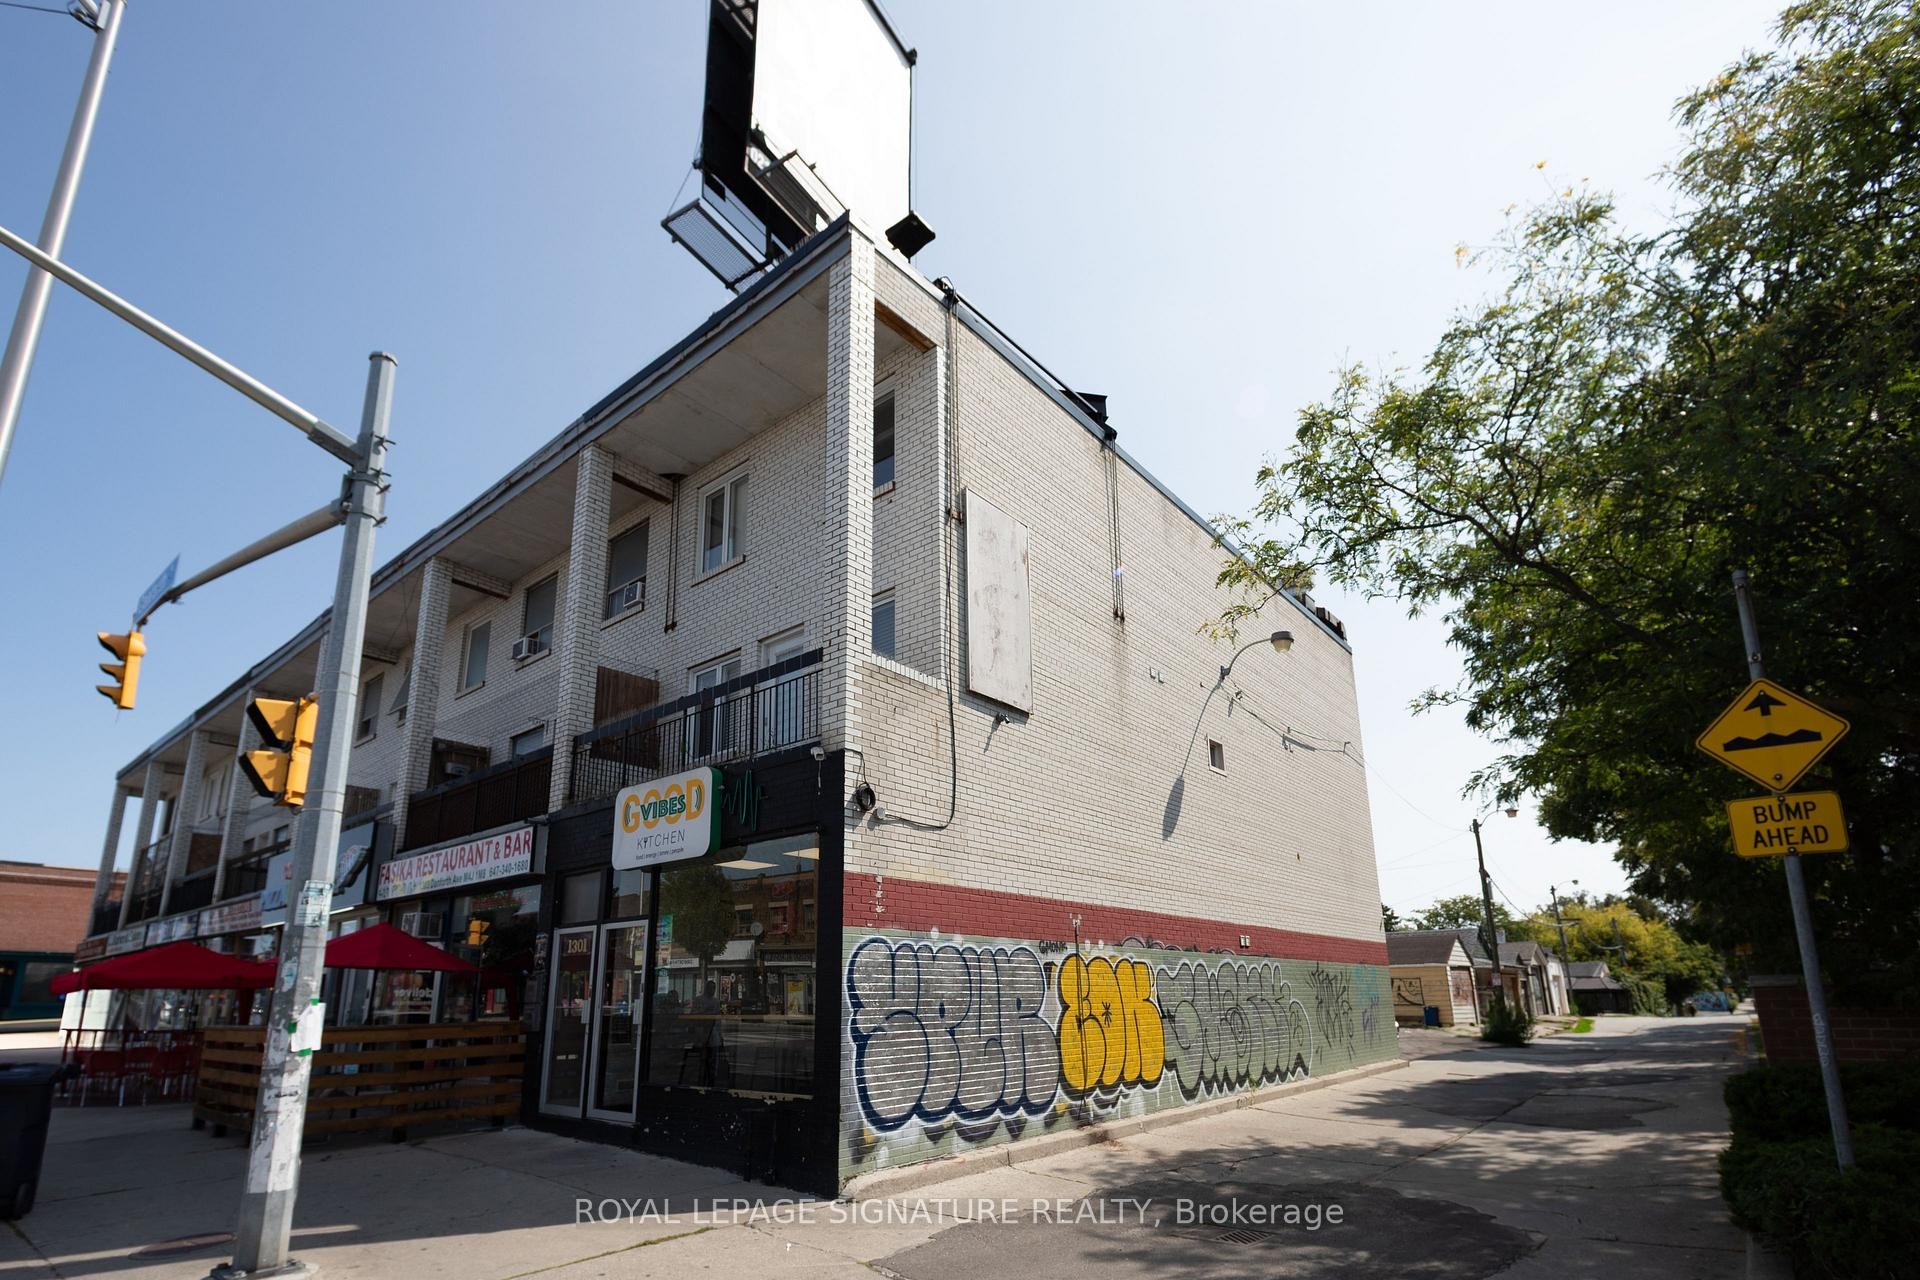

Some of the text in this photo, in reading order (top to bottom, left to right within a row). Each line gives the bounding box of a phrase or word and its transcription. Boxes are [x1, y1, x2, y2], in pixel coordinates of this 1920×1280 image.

[622, 779, 705, 833] GOOD
[640, 794, 686, 821] VIBES
[1753, 801, 1817, 824] BUMP
[636, 829, 686, 850] KITCHEN
[1753, 825, 1829, 849] AHEAD
[378, 860, 413, 885] FASIKA
[416, 840, 493, 877] RESTAURANT
[494, 841, 501, 860] &
[504, 831, 532, 858] BAR
[567, 938, 588, 954] 1301
